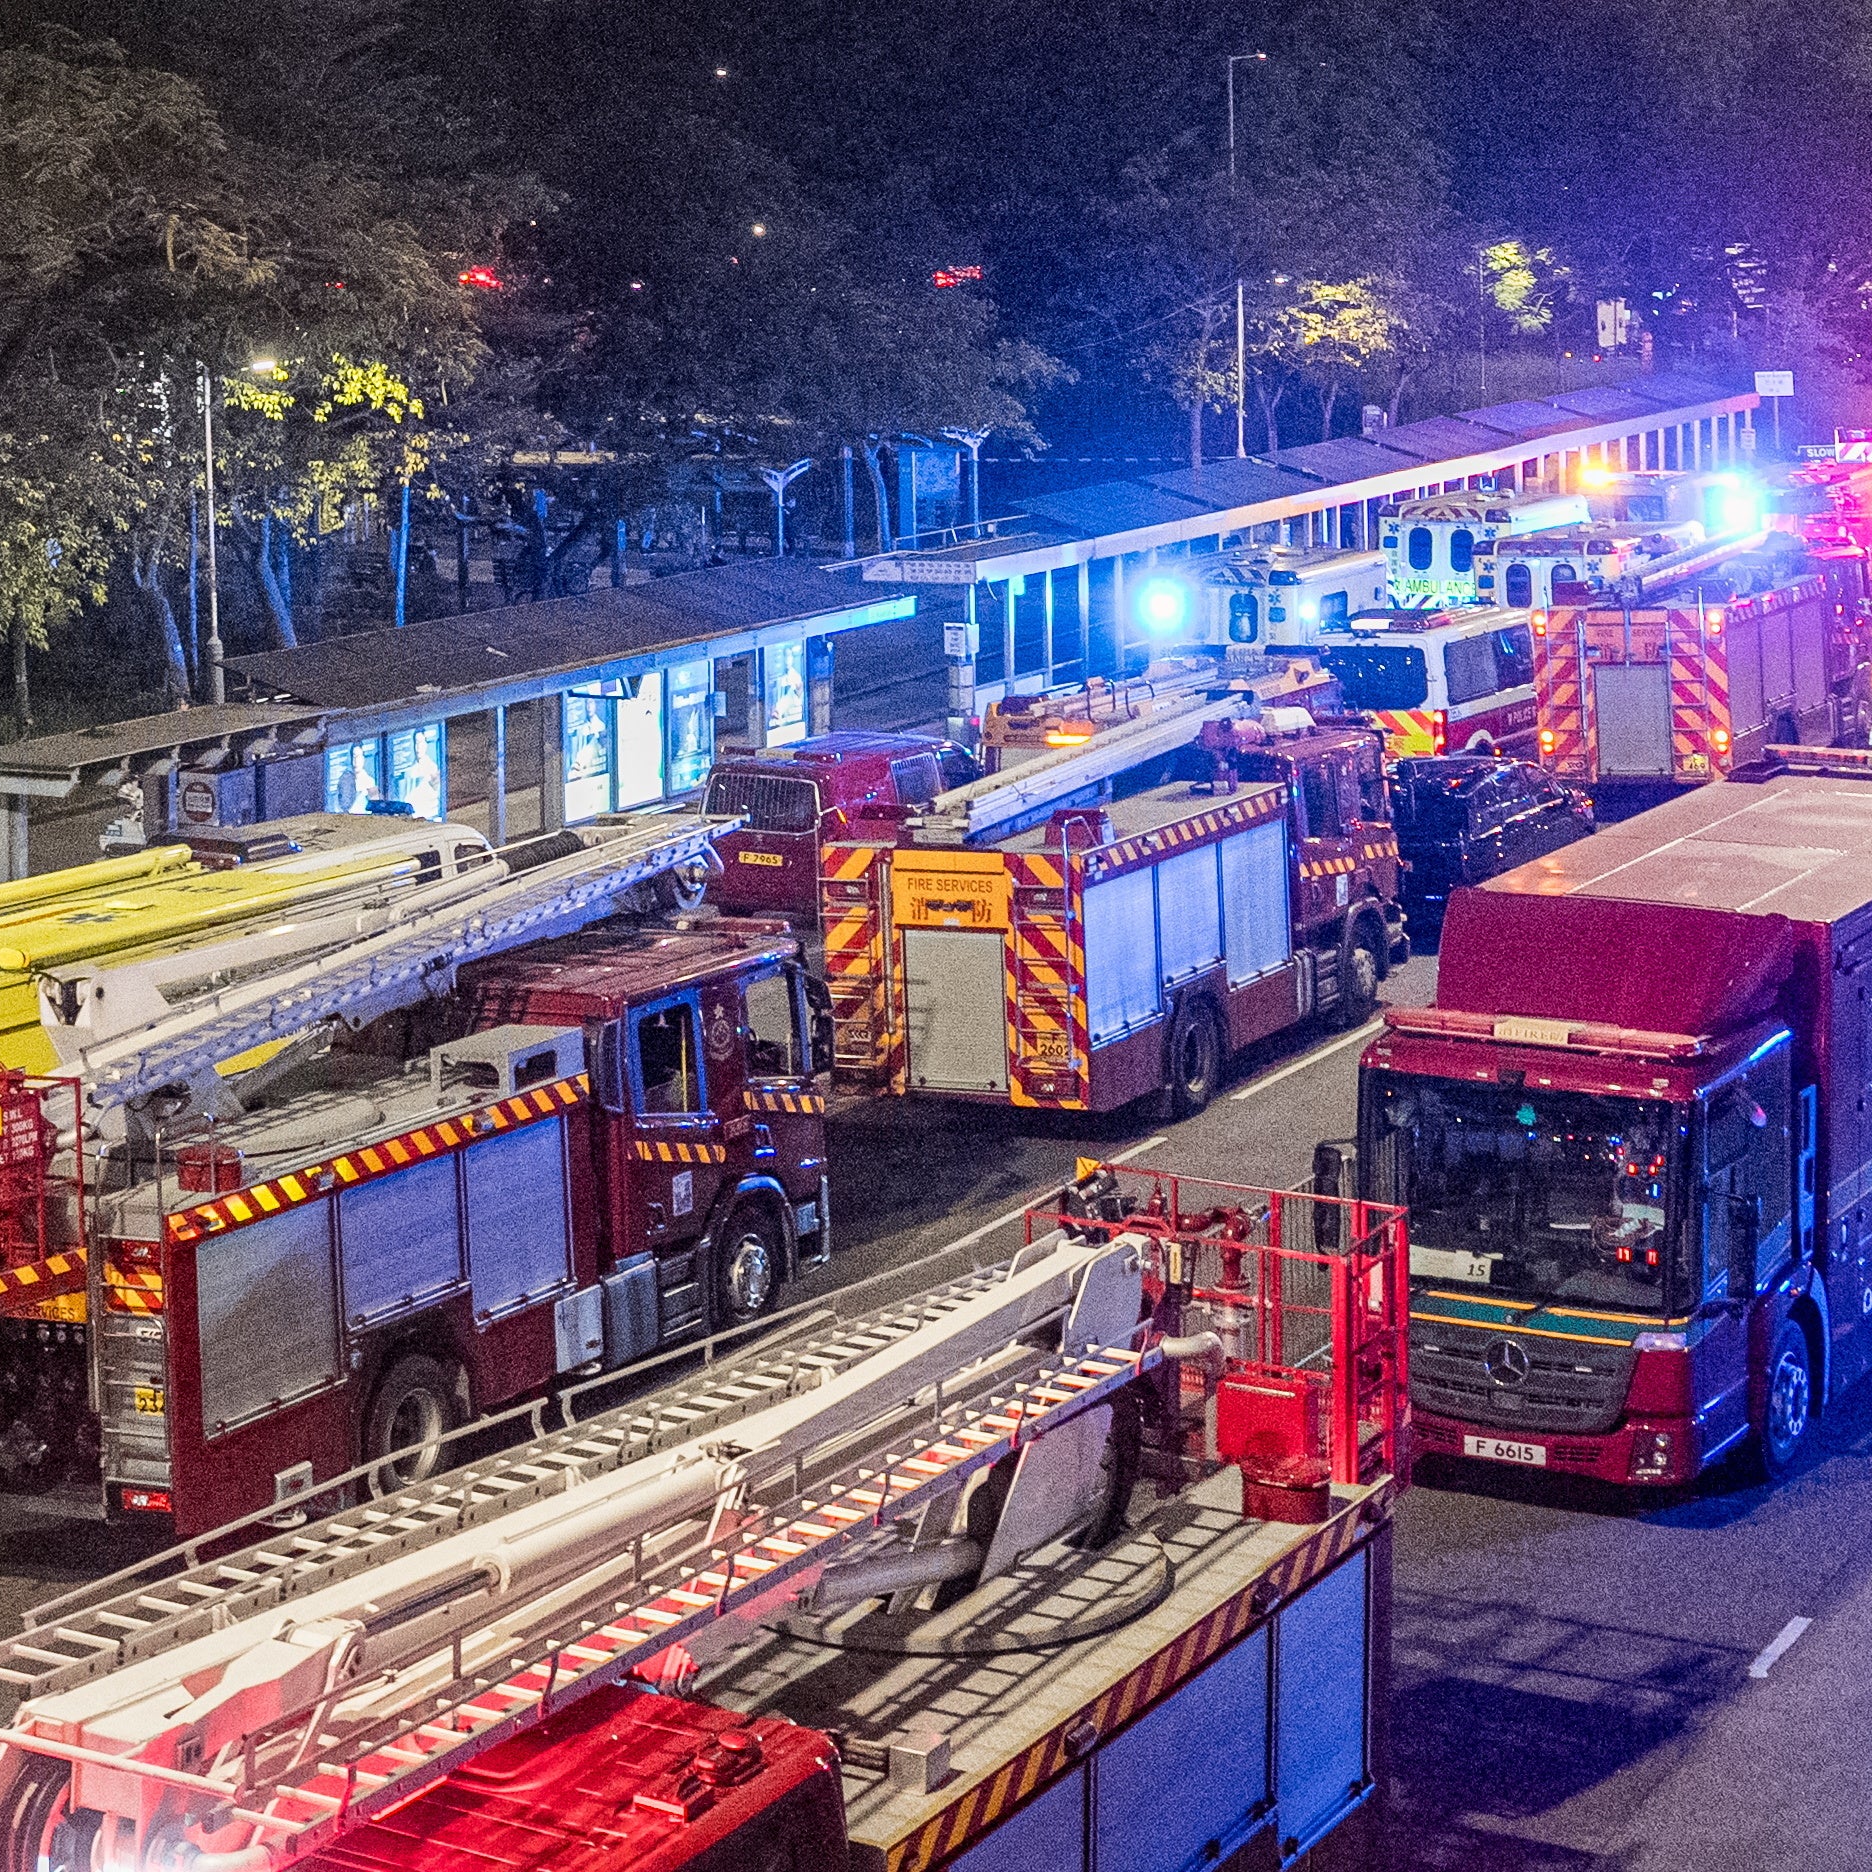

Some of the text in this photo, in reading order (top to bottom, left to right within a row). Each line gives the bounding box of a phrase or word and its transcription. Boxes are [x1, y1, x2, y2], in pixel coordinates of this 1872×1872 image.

[1806, 448, 1835, 457] SLOW
[907, 877, 993, 894] FIRE SERVICES
[1467, 1263, 1486, 1277] 15
[1476, 1439, 1534, 1462] F 6615
